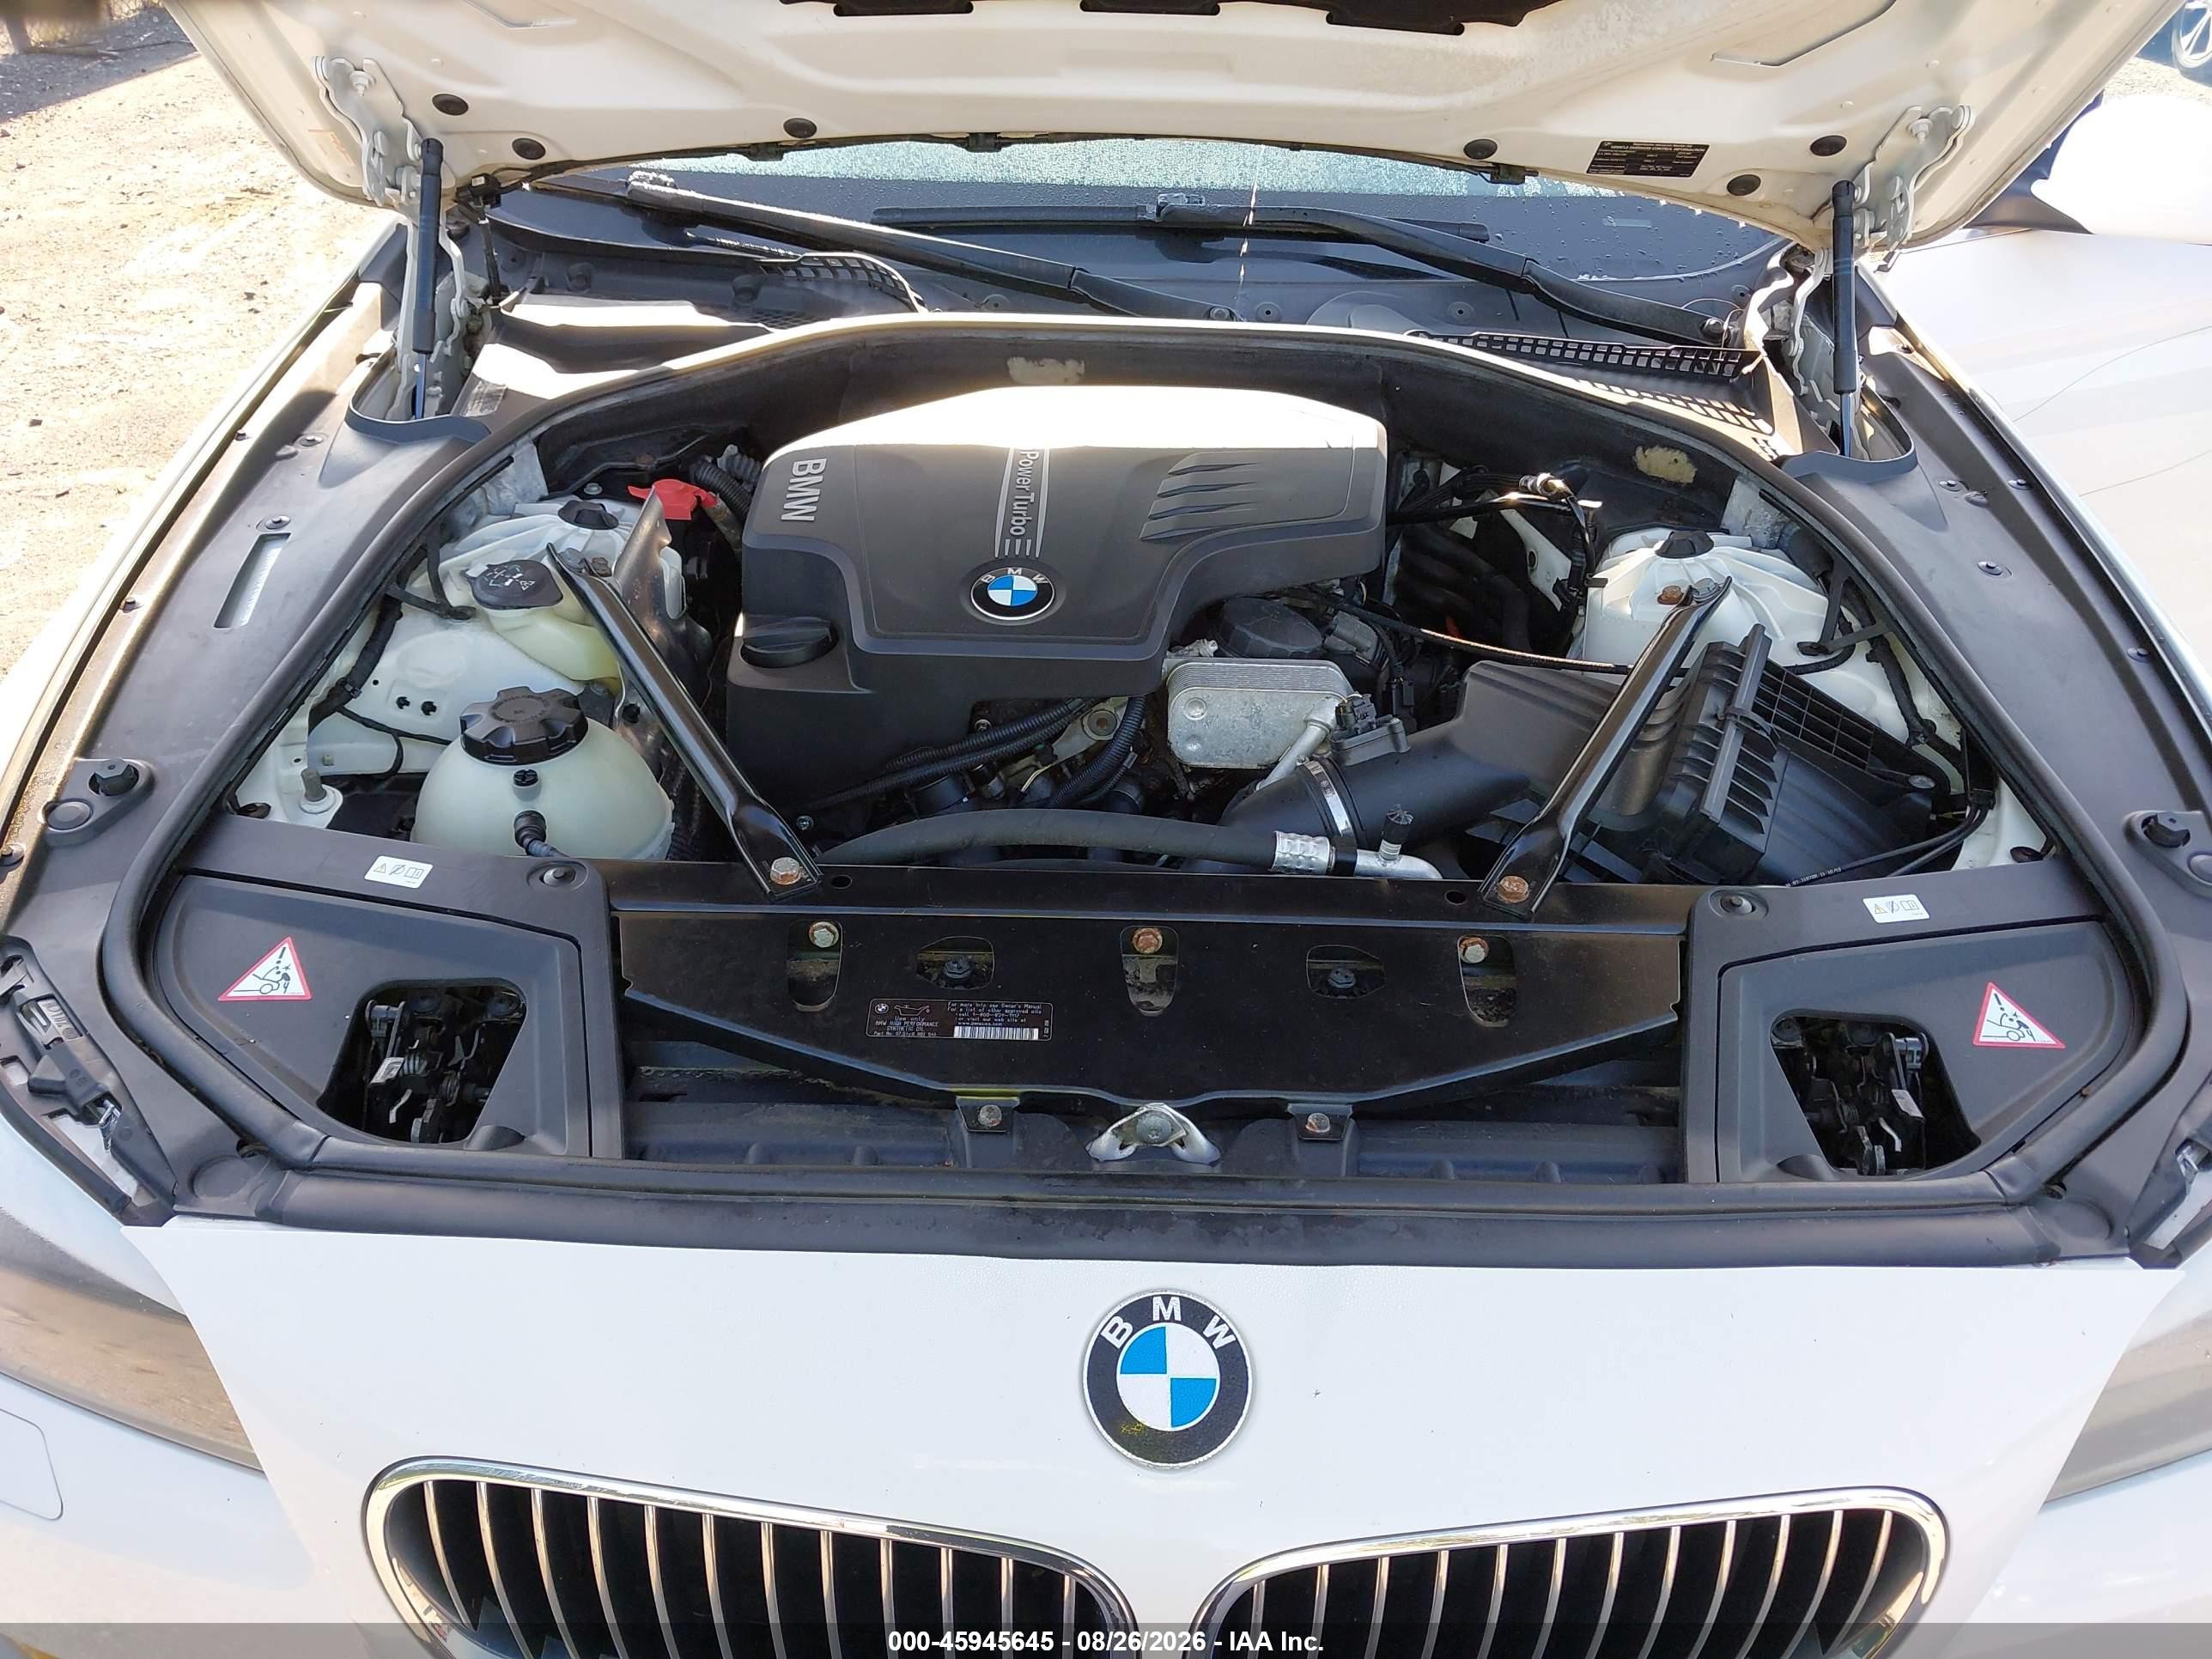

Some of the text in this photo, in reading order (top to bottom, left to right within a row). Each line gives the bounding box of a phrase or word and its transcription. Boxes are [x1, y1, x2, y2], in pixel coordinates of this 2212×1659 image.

[781, 458, 827, 521] BMW
[981, 567, 1048, 585] BMW
[1100, 1297, 1237, 1350] BMW
